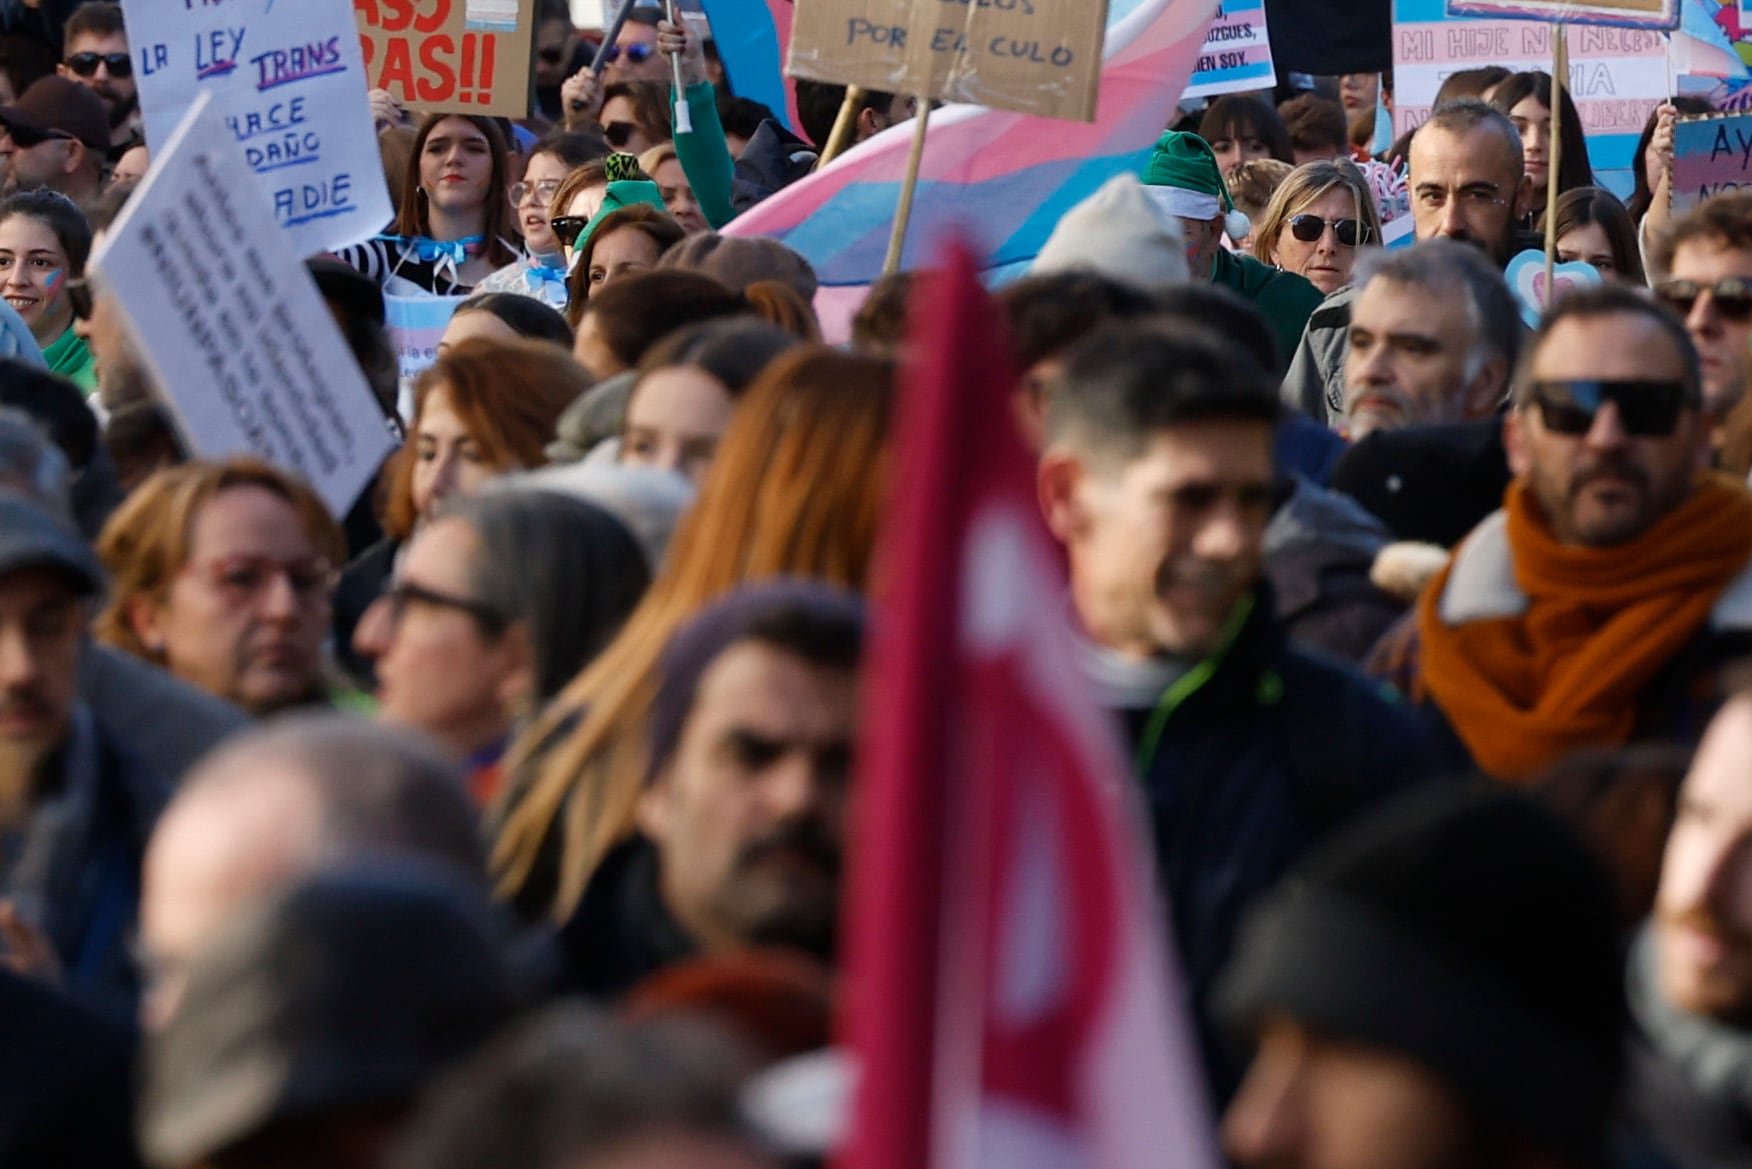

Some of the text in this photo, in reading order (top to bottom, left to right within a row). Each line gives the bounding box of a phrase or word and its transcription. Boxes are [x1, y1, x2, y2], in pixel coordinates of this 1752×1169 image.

[847, 18, 906, 47] POR
[989, 36, 1074, 68] CULO
[1204, 23, 1257, 45] UZGUES,
[1401, 30, 1434, 61] MI
[1448, 27, 1509, 58] HIJE
[142, 28, 340, 86] LA LEY TRANS
[1193, 55, 1217, 73] IEN
[246, 132, 320, 166] DAÑO
